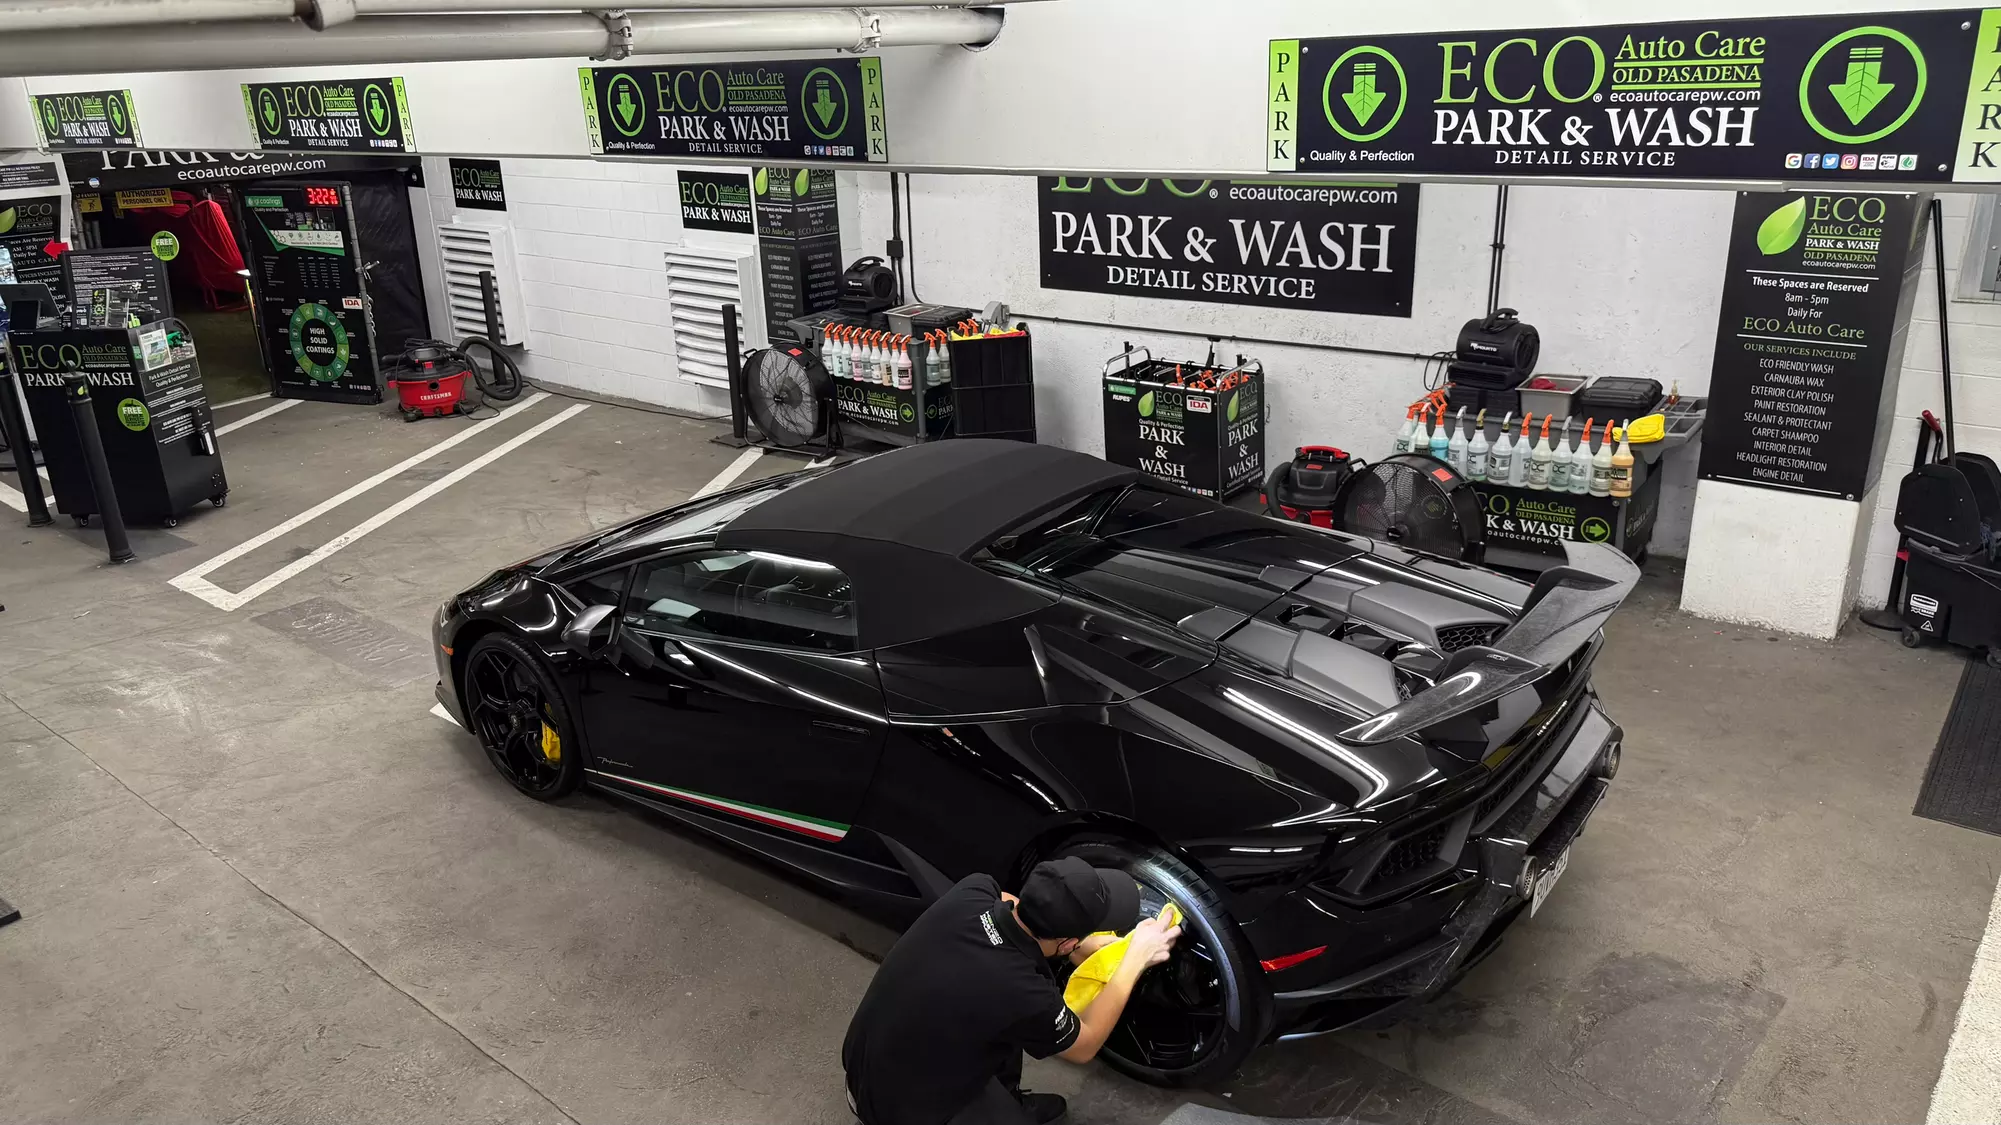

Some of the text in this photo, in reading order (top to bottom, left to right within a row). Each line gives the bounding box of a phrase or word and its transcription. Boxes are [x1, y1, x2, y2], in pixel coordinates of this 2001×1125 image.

[1614, 34, 1685, 60] Auto
[1695, 31, 1766, 57] Care
[726, 69, 754, 86] Auto
[756, 68, 785, 85] Care
[1612, 65, 1762, 84] OLD PASADENA
[323, 84, 338, 97] Auto
[339, 84, 354, 97] Care
[728, 90, 786, 101] OLD PASADENA
[1610, 90, 1761, 105] ecoautocarepw.com
[728, 105, 789, 115] ecoautocarepw.com
[62, 122, 83, 138] PARK
[87, 122, 111, 137] WASH
[288, 118, 363, 138] PARK & WASH
[658, 115, 791, 142] PARK & WASH
[1432, 106, 1760, 147] PARK & WASH
[307, 139, 350, 147] DETAIL SERVICE
[608, 142, 625, 151] Quality
[631, 142, 656, 151] Perfection
[689, 142, 763, 154] DETAIL SERVICE
[1310, 150, 1415, 163] Quality & Perfection
[1495, 150, 1676, 166] DETAIL SERVICE
[177, 158, 326, 181] ecoautocarepw.com
[121, 189, 166, 198] AUTHORIZED
[455, 188, 475, 200] PARK
[481, 190, 503, 202] WASH
[1229, 186, 1398, 206] ecoautocarepw.com
[683, 206, 710, 220] PARK
[711, 208, 720, 221] &
[720, 208, 752, 223] WASH
[1807, 222, 1882, 237] Auto Care
[1051, 211, 1396, 273] PARK & WASH
[1805, 238, 1880, 250] PARK & WASH
[1802, 260, 1876, 270] ecoautocarepw.com
[1803, 251, 1877, 263] OLD PASADENA
[1106, 265, 1316, 300] DETAIL SERVICE
[1752, 276, 1869, 293] These Spaces are Reserved
[1785, 293, 1803, 303] 8am
[1810, 294, 1829, 305] 5pm
[1787, 307, 1823, 319] Daily For
[310, 327, 326, 335] HIGH
[1743, 316, 1865, 339] ECO Auto Care
[82, 343, 104, 353] Auto
[105, 343, 127, 353] Care
[310, 336, 328, 345] SOLID
[306, 346, 335, 355] COATINGS
[1743, 342, 1857, 360] OUR SERVICES INCLUDE
[1759, 358, 1835, 374] ECO FRIENDLY WASH
[86, 372, 135, 386] WASH
[1764, 372, 1825, 387] CARNAUBA WAX
[420, 391, 452, 401] CRAFTSMAN
[867, 390, 880, 399] Auto
[882, 391, 897, 402] Care
[1751, 385, 1835, 403] EXTERIOR CLAY POLISH
[122, 406, 143, 415] FREE
[837, 399, 898, 420] PARK & WASH
[1189, 400, 1209, 409] IDA
[1754, 399, 1827, 416] PAINT RESTORATION
[1160, 422, 1185, 430] Perfection
[1743, 411, 1833, 431] SEALANT & PROTECTANT
[1138, 424, 1185, 445] PARK
[1228, 418, 1259, 448] PARK
[1752, 426, 1820, 444] CARPET SHAMPOO
[1154, 445, 1169, 460] &
[1239, 443, 1249, 458] &
[1753, 440, 1813, 457] INTERIOR DETAIL
[1138, 457, 1186, 478] WASH
[1228, 452, 1260, 480] WASH
[1736, 451, 1828, 472] HEADLIGHT RESTORATION
[1752, 467, 1805, 483] ENGINE DETAIL
[1515, 497, 1545, 511] Auto
[1547, 501, 1576, 515] Care
[1515, 510, 1575, 525] OLD PASADENA
[1502, 519, 1516, 532] &
[1519, 518, 1575, 540] WASH
